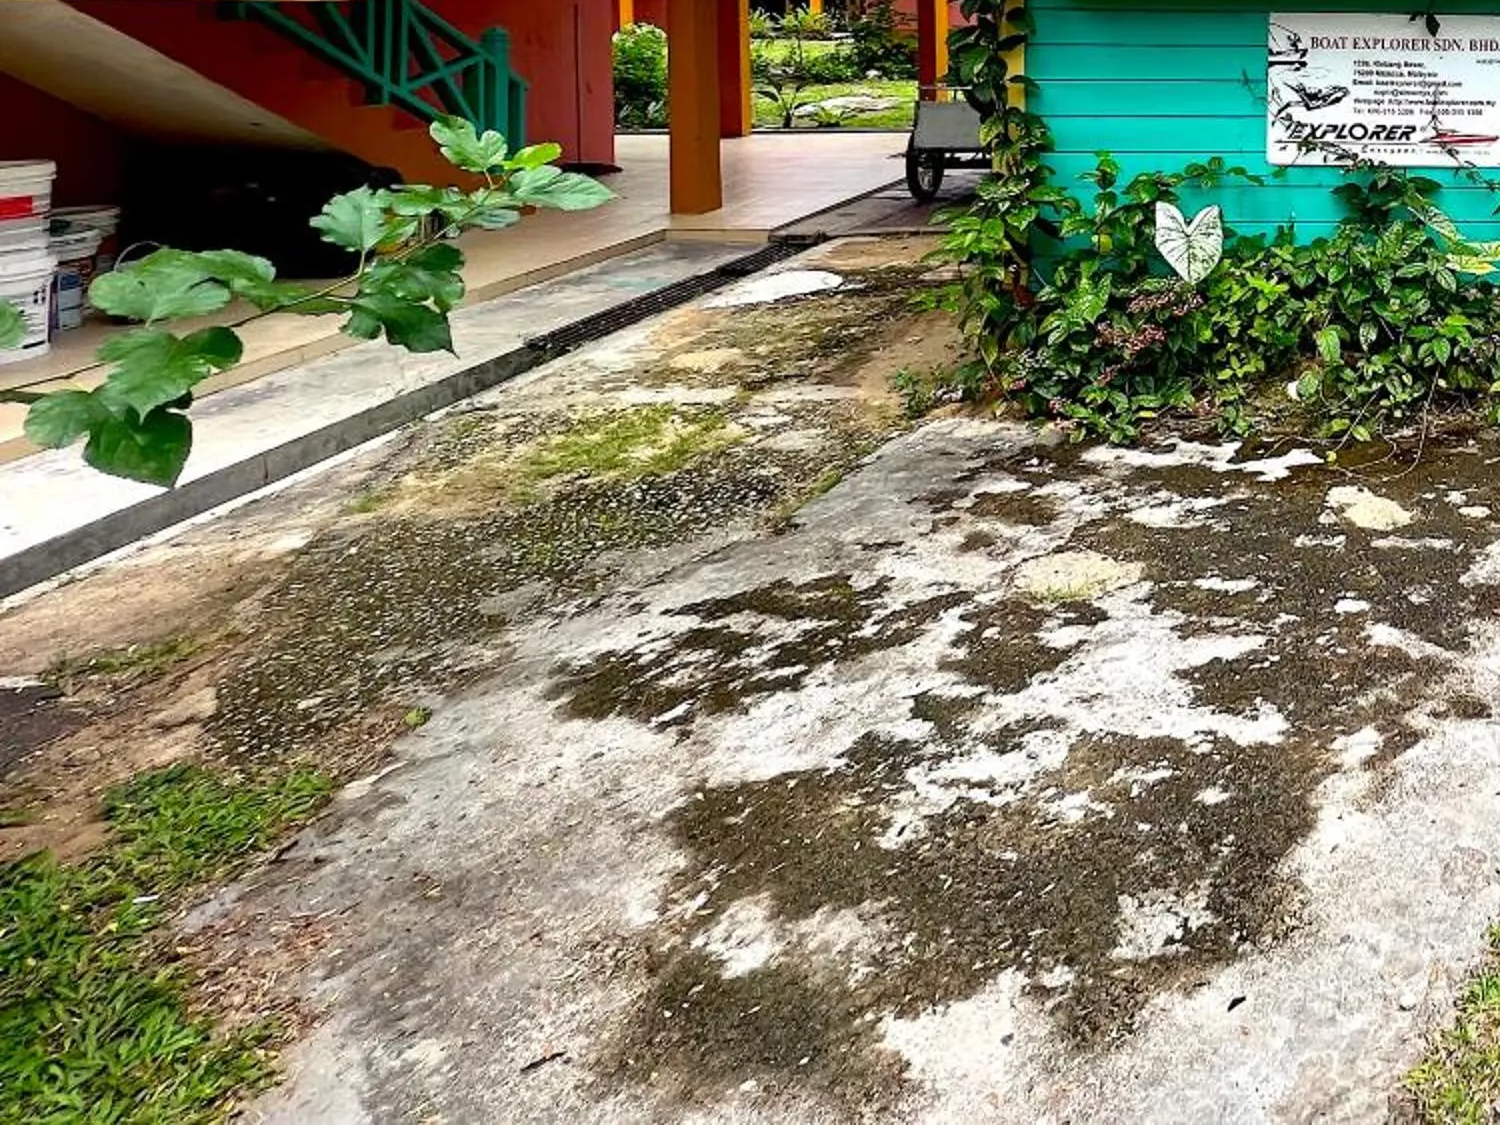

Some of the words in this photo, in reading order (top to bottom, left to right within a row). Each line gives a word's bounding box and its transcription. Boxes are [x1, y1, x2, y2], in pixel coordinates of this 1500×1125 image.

[1310, 36, 1349, 50] BOAT
[1352, 37, 1430, 52] EXPLORER
[1432, 38, 1465, 52] SDN.
[1288, 123, 1417, 142] EXPLORER
